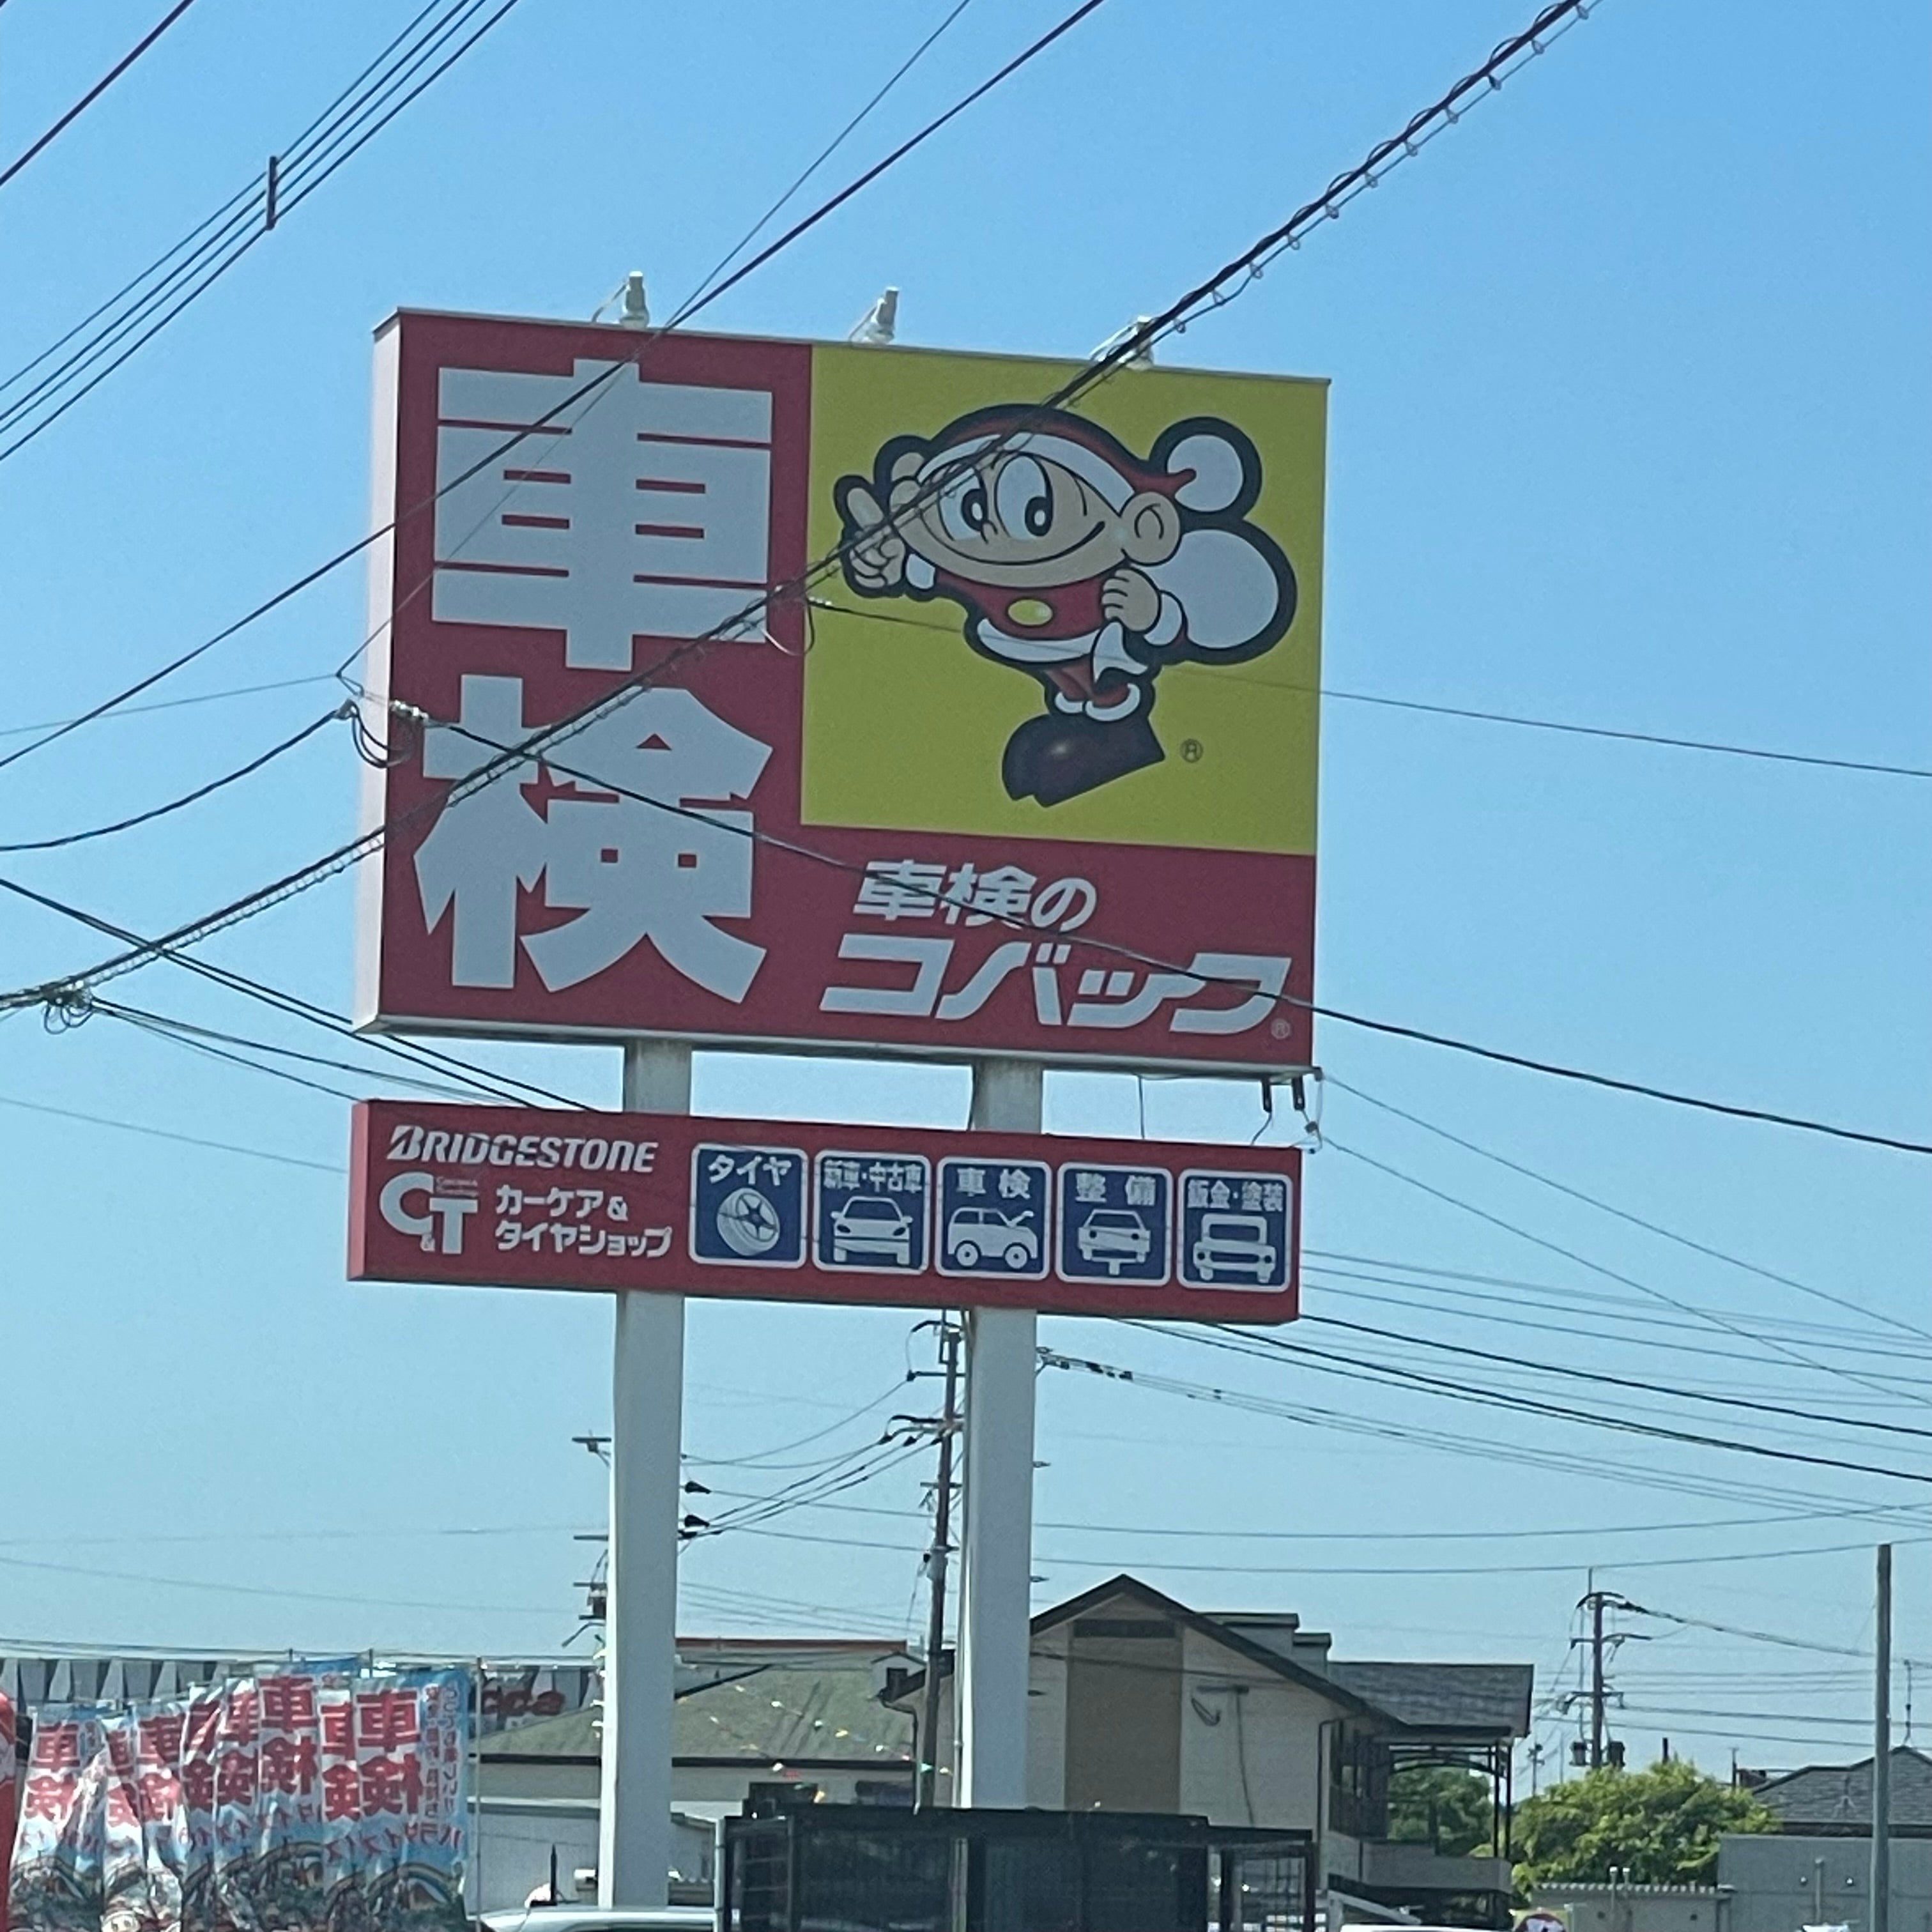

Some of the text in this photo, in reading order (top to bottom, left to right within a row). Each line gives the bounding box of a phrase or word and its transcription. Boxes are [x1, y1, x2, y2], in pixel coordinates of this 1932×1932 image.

[413, 358, 773, 1004] 車検
[853, 859, 1097, 931] 車検の
[820, 933, 1292, 1034] コバック
[387, 1125, 659, 1173] BRIDGESTONE
[707, 1154, 792, 1186] タイヤ
[495, 1184, 629, 1222] カーケア&
[957, 1167, 1031, 1199] 車検
[495, 1221, 673, 1258] タイヤショップ
